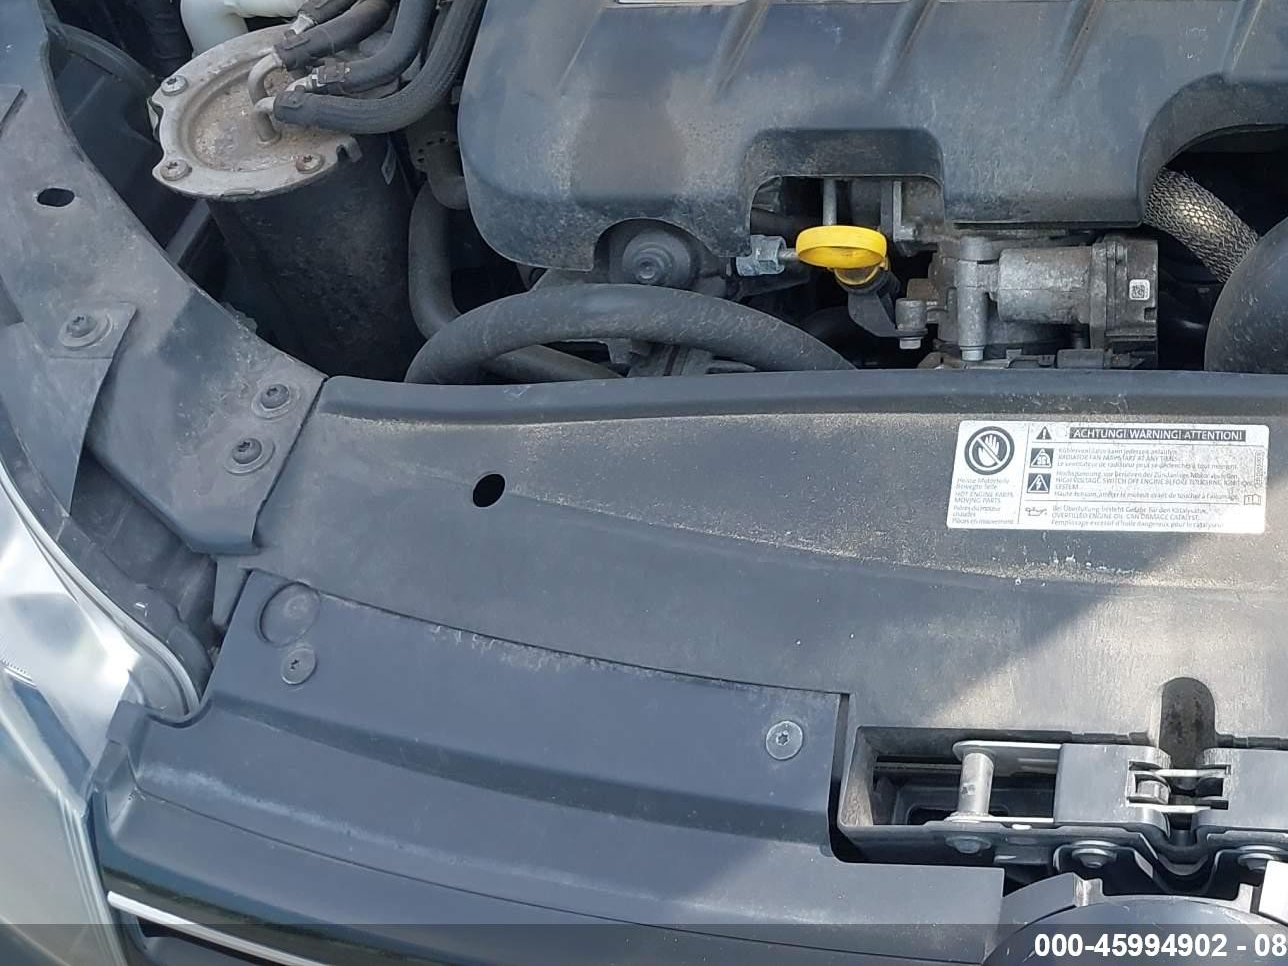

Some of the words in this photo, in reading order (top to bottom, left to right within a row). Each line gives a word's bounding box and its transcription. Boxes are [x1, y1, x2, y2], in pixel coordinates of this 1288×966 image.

[1073, 428, 1126, 438] ACHTUNG!
[1128, 429, 1181, 439] WARNING!
[1184, 430, 1242, 440] ATTENTION!
